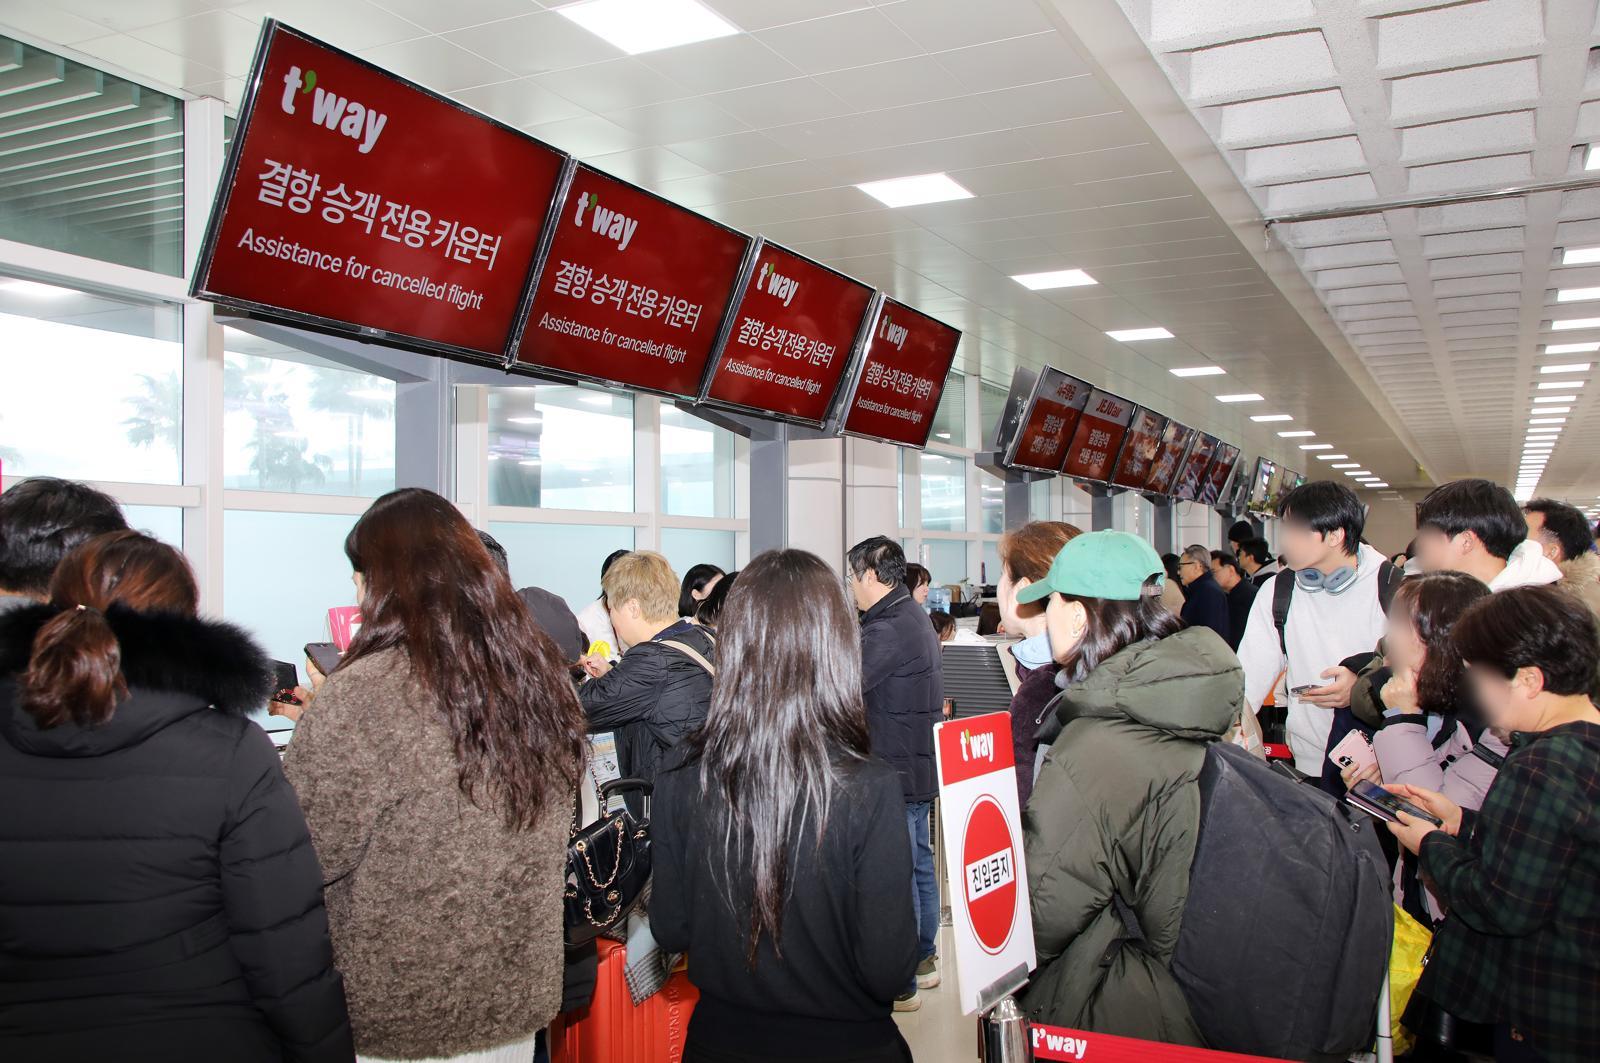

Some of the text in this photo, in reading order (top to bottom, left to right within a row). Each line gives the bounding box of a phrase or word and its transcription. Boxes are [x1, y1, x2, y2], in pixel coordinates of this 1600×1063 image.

[281, 66, 387, 154] t'way
[258, 158, 502, 271] 결항 승객 전용 카운터
[575, 192, 638, 250] t'way
[238, 228, 484, 311] Assistance for cancelled flight
[757, 263, 799, 307] t'way
[555, 261, 703, 332] 결항 승객 전용 카운터
[539, 312, 687, 364] Assistance for cancelled flight
[738, 318, 837, 369] 결항 승객 전용 카운터
[880, 316, 909, 351] t'way
[725, 359, 822, 396] Assistance for cancelled flight
[856, 396, 923, 425] Assistance for cancelled flight
[960, 729, 994, 762] t'way
[972, 853, 1010, 892] 진입금지
[1033, 1028, 1087, 1059] t'way
